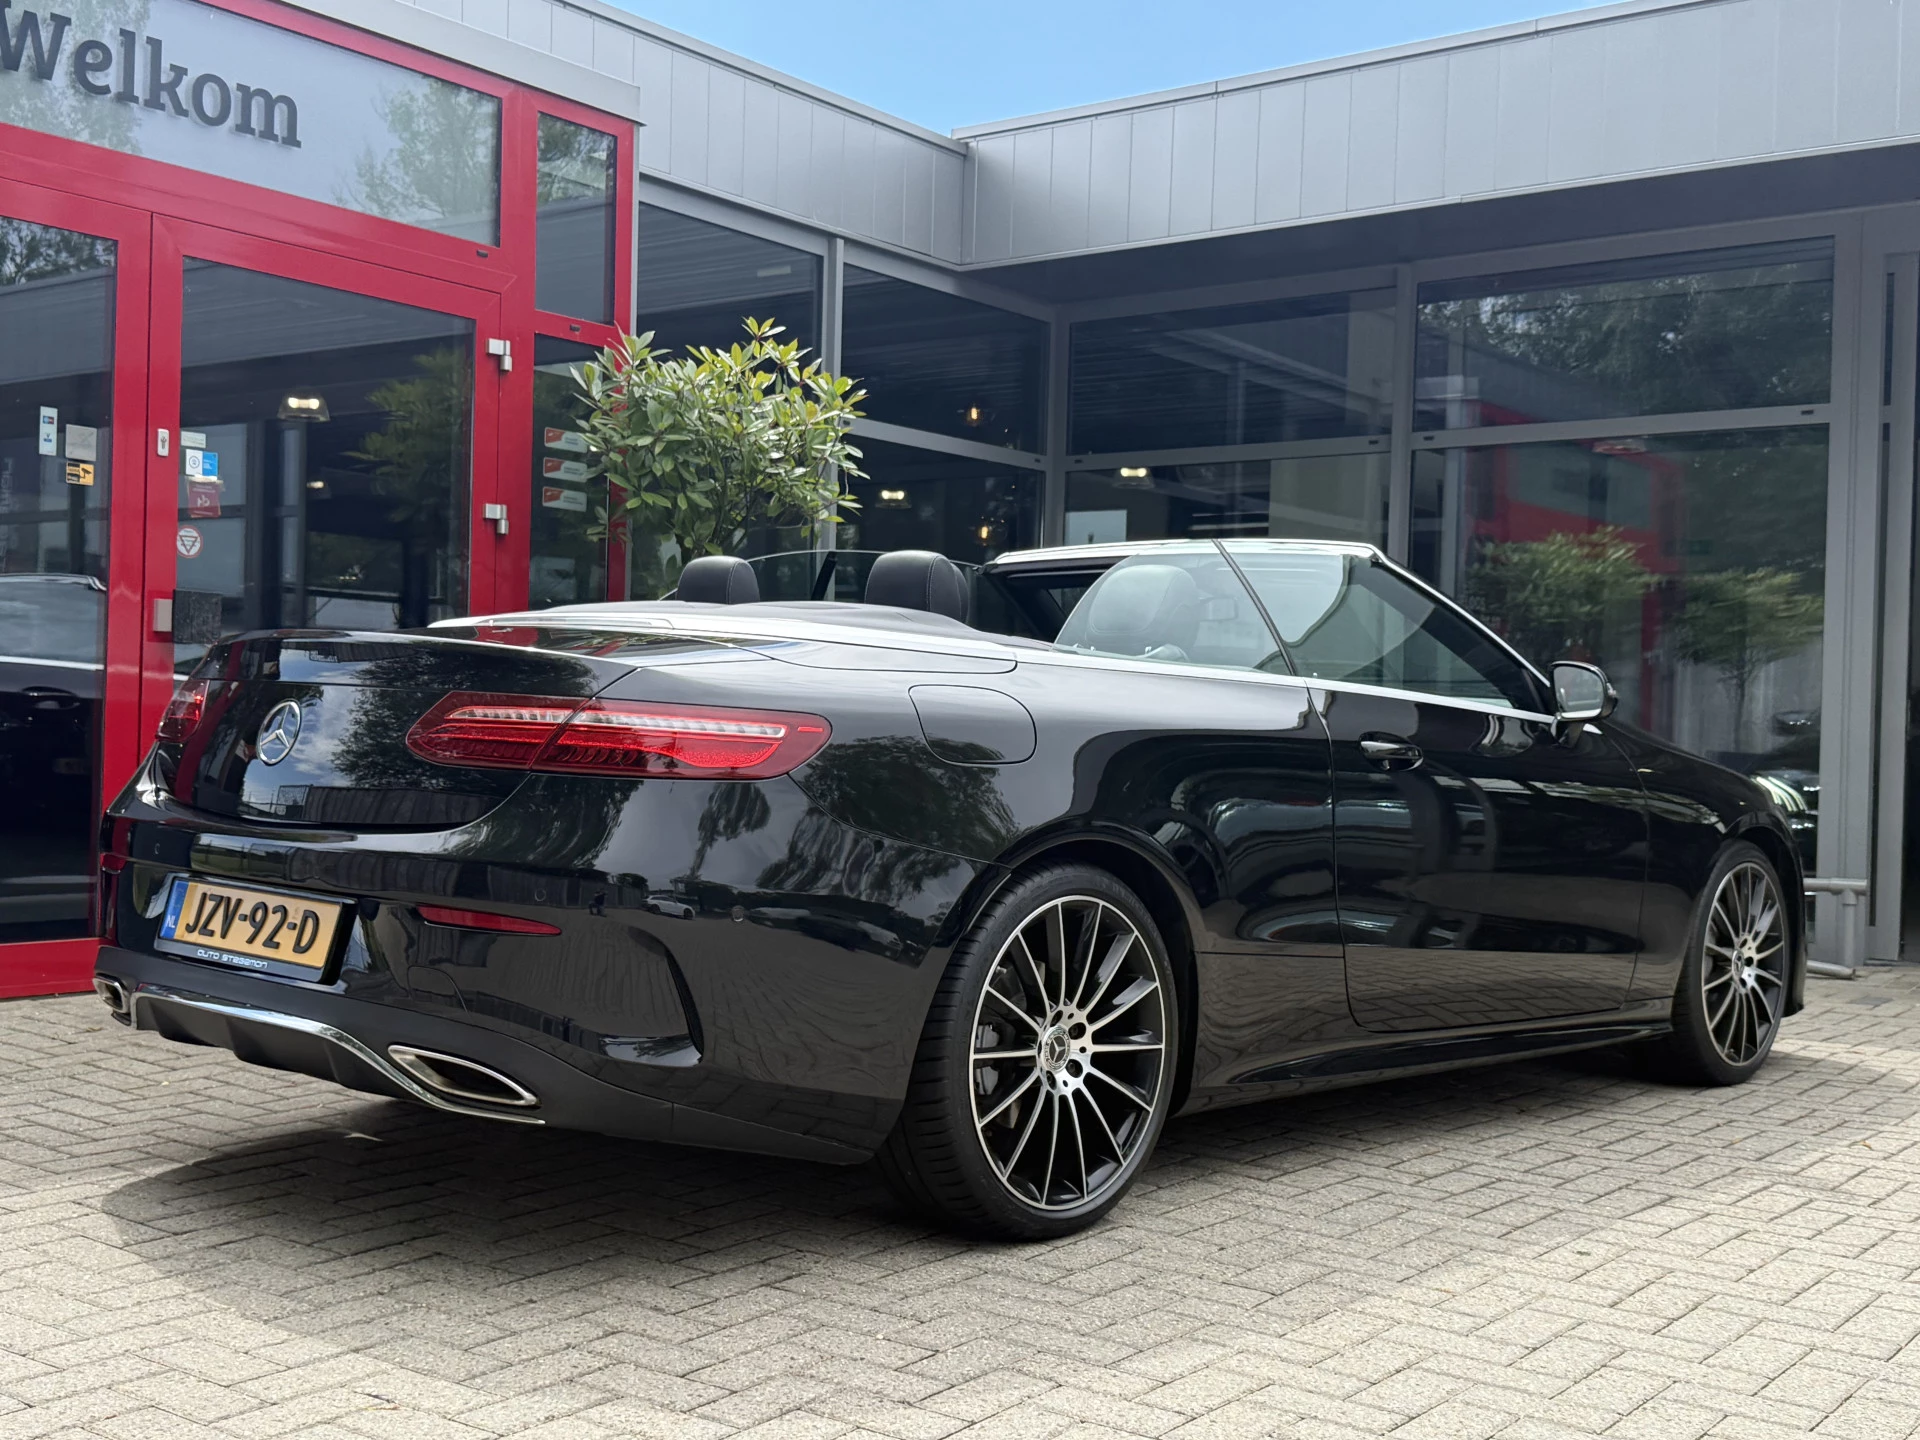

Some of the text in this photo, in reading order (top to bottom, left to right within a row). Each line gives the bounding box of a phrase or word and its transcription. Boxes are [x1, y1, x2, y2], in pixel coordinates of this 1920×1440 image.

[0, 0, 302, 149] Welkom
[165, 914, 176, 929] NL
[185, 892, 320, 954] JZV-92-D
